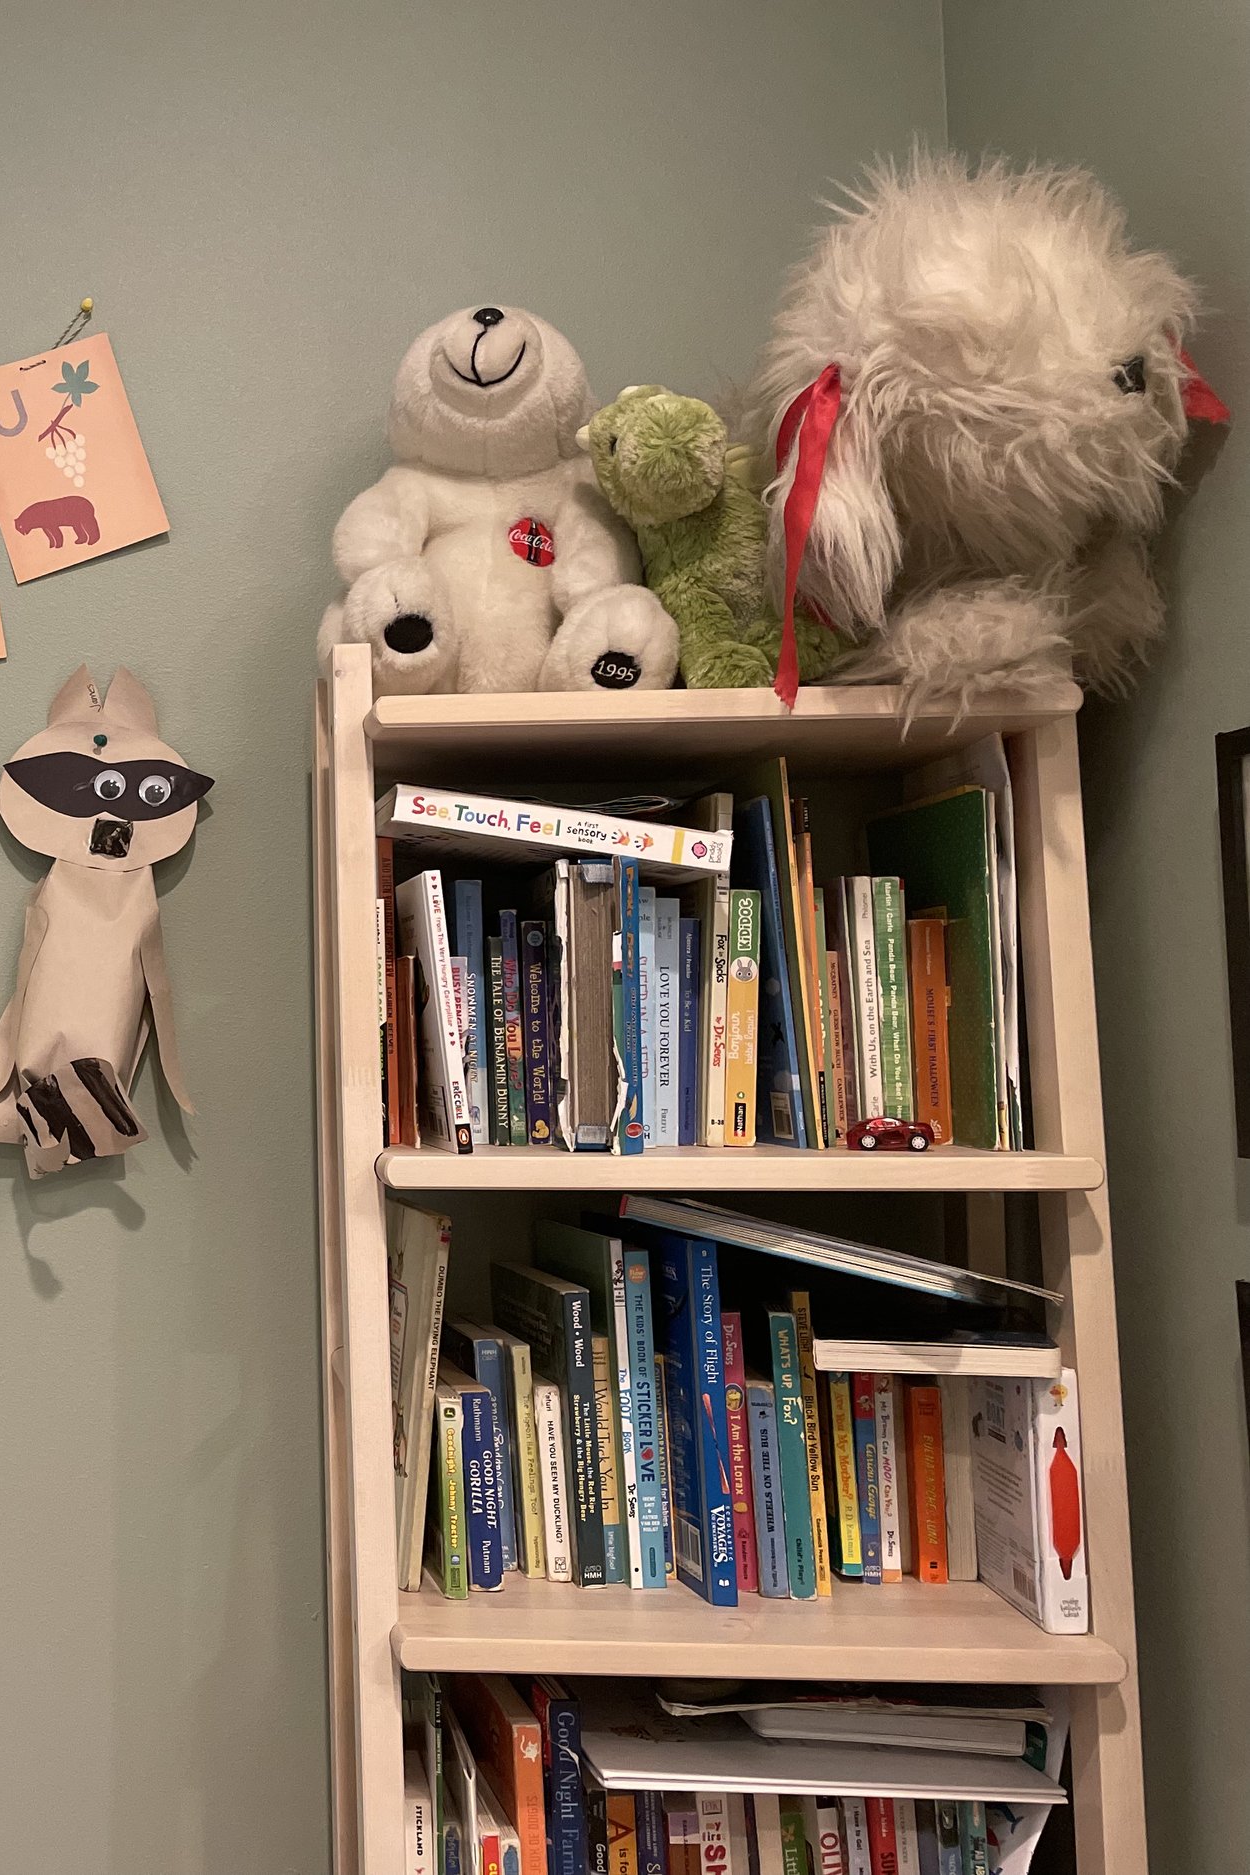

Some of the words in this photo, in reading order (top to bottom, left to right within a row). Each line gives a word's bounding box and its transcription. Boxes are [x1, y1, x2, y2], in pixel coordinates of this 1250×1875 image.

[594, 660, 638, 682] 1995
[454, 804, 511, 831] Touch,
[516, 813, 561, 837] Feel
[566, 826, 608, 841] sensory
[578, 837, 593, 845] book
[716, 842, 725, 864] books
[885, 882, 893, 906] Martin
[715, 934, 728, 951] Fox
[862, 940, 871, 956] Sea
[438, 947, 447, 964] Very
[491, 956, 502, 976] THE
[864, 959, 872, 976] and
[440, 965, 449, 988] Hungry
[452, 966, 461, 994] BUSY
[503, 959, 517, 989] Who
[659, 966, 670, 1000] LOVE
[715, 957, 727, 984] Socks
[492, 980, 503, 1004] TALE
[530, 962, 542, 1014] Welcome
[865, 978, 874, 1003] Earth
[890, 985, 898, 1009] Panda
[443, 990, 454, 1026] Caterpillar
[466, 972, 477, 1030] SNOWMEN
[505, 991, 519, 1012] Do
[867, 1006, 875, 1020] the
[493, 1008, 504, 1022] OF
[531, 1020, 542, 1033] to
[659, 1002, 670, 1029] YOU
[683, 1018, 692, 1032] Kid
[469, 1034, 479, 1047] AT
[506, 1015, 520, 1043] You
[713, 1025, 725, 1041] Dr.
[728, 1011, 743, 1060] Bonjour
[893, 1032, 901, 1051] What
[927, 1030, 937, 1052] FIRST
[494, 1027, 507, 1084] BENJAMIN
[531, 1038, 545, 1060] the
[659, 1031, 670, 1088] FOREVER
[713, 1041, 725, 1068] Seuss
[508, 1046, 524, 1090] Love?
[869, 1055, 878, 1079] With
[451, 1081, 462, 1099] ERIC
[532, 1065, 547, 1105] World!
[929, 1055, 940, 1107] HALLOWEEN
[452, 1099, 463, 1120] CARLE
[497, 1088, 509, 1129] BUNNY
[437, 1265, 446, 1298] DUMBO
[700, 1264, 713, 1289] The
[435, 1300, 443, 1315] THE
[571, 1300, 583, 1330] Wood
[633, 1294, 643, 1312] THE
[701, 1293, 715, 1325] Story
[432, 1317, 441, 1346] FLYING
[635, 1315, 645, 1338] KIDS'
[723, 1323, 734, 1340] Dr.
[797, 1306, 809, 1332] STEVE
[705, 1330, 718, 1346] of
[778, 1329, 791, 1369] WHAT'S
[798, 1332, 810, 1354] LIGHT
[574, 1339, 585, 1368] Wood
[636, 1340, 646, 1364] BOOK
[725, 1340, 737, 1366] Seuss
[428, 1347, 438, 1391] ELEPHANT
[638, 1366, 647, 1378] OF
[704, 1349, 720, 1384] Flight
[472, 1398, 482, 1442] Rathmann
[572, 1393, 582, 1437] Strawberry
[582, 1402, 590, 1417] The
[595, 1387, 609, 1430] Would
[636, 1381, 653, 1438] STICKER
[782, 1397, 798, 1426] Fox?
[804, 1395, 814, 1420] Black
[523, 1413, 533, 1439] Pigeon
[547, 1420, 555, 1441] HAVE
[583, 1417, 592, 1439] Little
[731, 1423, 741, 1441] Am
[760, 1430, 769, 1447] BUS
[807, 1422, 817, 1441] Bird
[880, 1415, 890, 1439] Brown
[446, 1428, 457, 1476] Goodnight,
[576, 1447, 584, 1459] the
[584, 1440, 593, 1466] Mouse,
[597, 1432, 611, 1463] Tuck
[657, 1418, 667, 1485] INFORMATION
[732, 1444, 743, 1462] the
[837, 1433, 848, 1453] My
[482, 1450, 494, 1486] GOOD
[577, 1460, 585, 1472] Big
[762, 1452, 770, 1470] THE
[808, 1442, 818, 1473] Yellow
[865, 1442, 877, 1482] Curious
[550, 1460, 558, 1482] SEEN
[586, 1466, 594, 1479] the
[600, 1467, 614, 1492] You
[734, 1464, 746, 1495] Lorax
[764, 1474, 772, 1489] ON
[810, 1474, 820, 1492] Sun
[840, 1455, 853, 1500] Mother?
[448, 1479, 457, 1512] Johnny
[470, 1460, 483, 1515] GORILLA
[552, 1484, 559, 1496] MY
[577, 1474, 587, 1502] Hungry
[587, 1480, 596, 1495] Red
[627, 1483, 637, 1496] Dr.
[660, 1488, 668, 1501] for
[484, 1488, 498, 1530] NIGHT,
[580, 1504, 588, 1522] Bear
[588, 1496, 597, 1514] Ripe
[601, 1497, 615, 1511] In
[628, 1496, 637, 1519] Seuss
[765, 1492, 775, 1533] WHEELS
[865, 1483, 879, 1520] George
[553, 1498, 563, 1544] DUCKLING?
[661, 1501, 669, 1528] babies
[450, 1514, 459, 1549] Tractor
[710, 1504, 729, 1563] VOYAGES
[725, 1505, 735, 1562] SCHOLASTIC
[886, 1530, 895, 1540] Dr.
[482, 1540, 492, 1574] Putnam
[606, 1546, 616, 1570] bigfoot
[887, 1540, 896, 1557] Seuss
[584, 1571, 603, 1579] HMH
[557, 1711, 576, 1761] Good
[555, 1770, 579, 1819] Night
[415, 1805, 424, 1857] STICKLAND
[608, 1818, 635, 1844] A
[595, 1843, 607, 1873] Good
[619, 1848, 629, 1858] is
